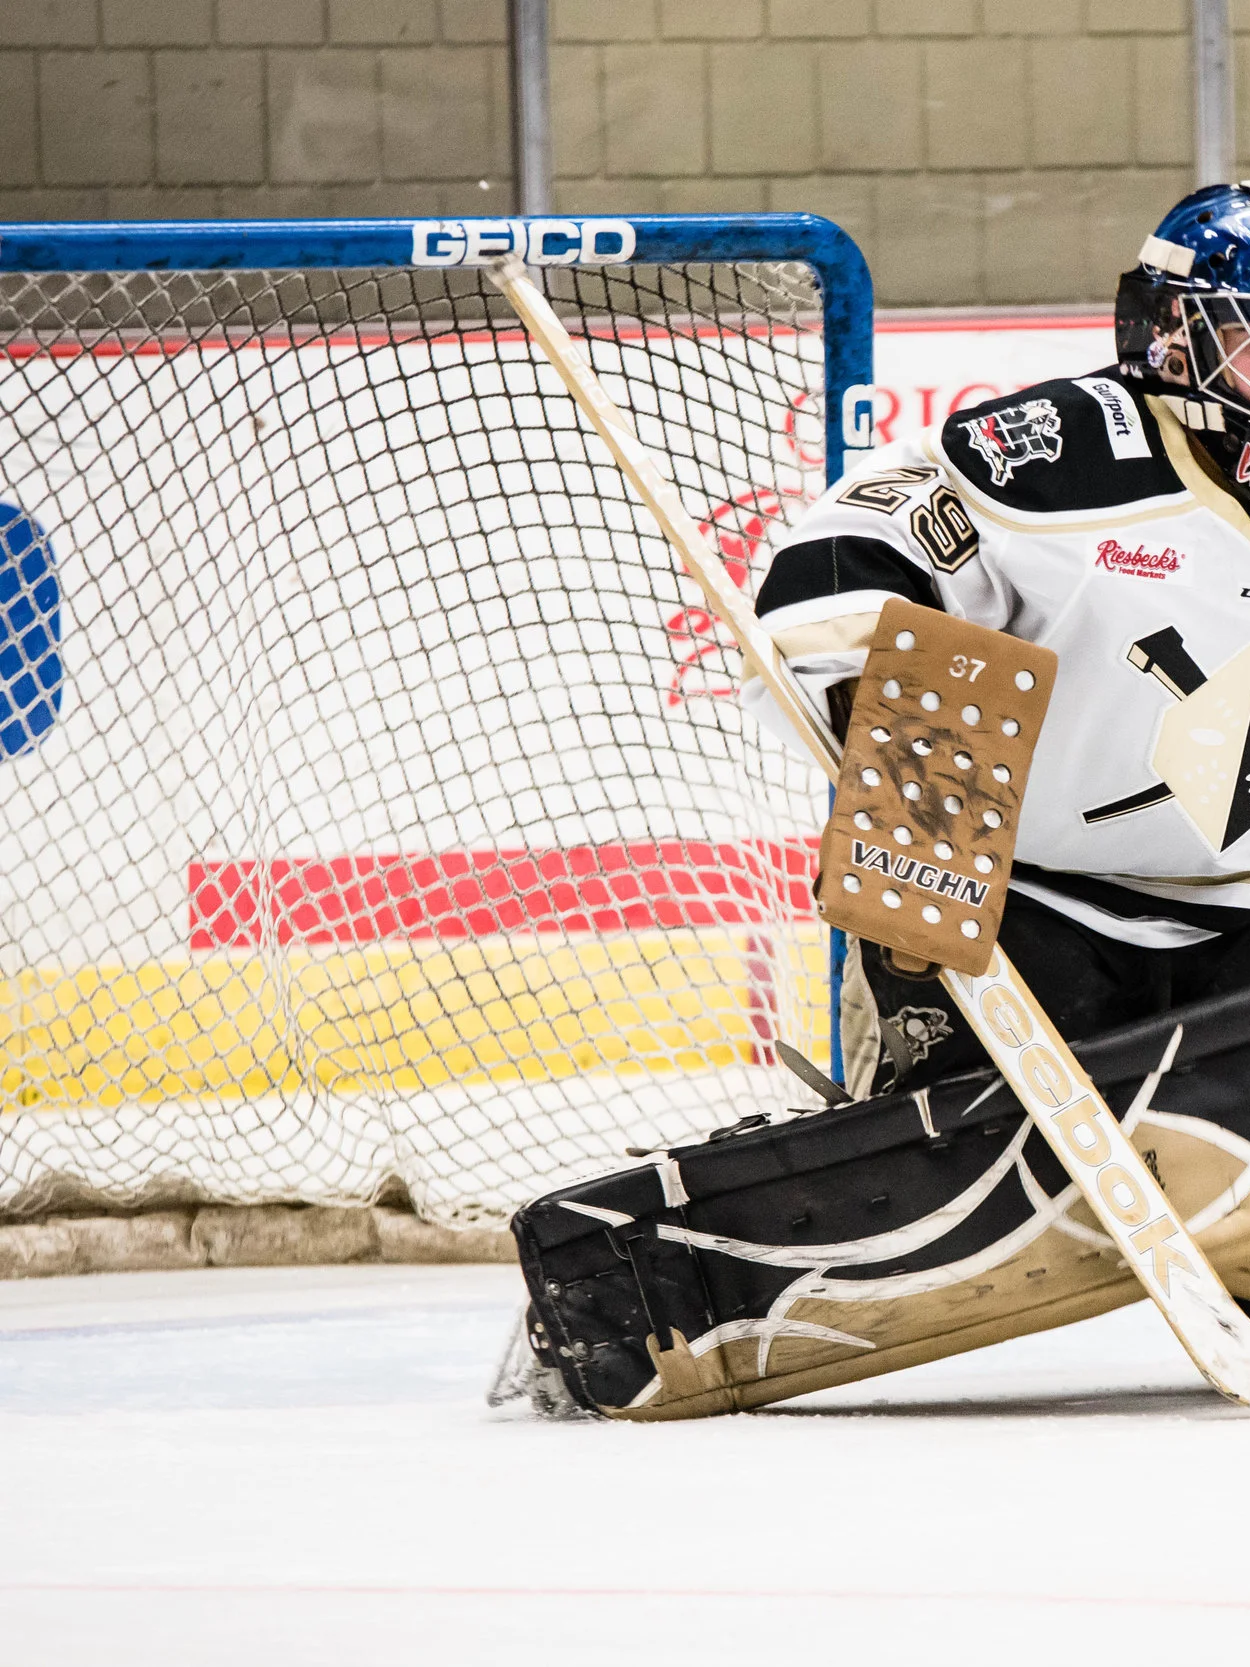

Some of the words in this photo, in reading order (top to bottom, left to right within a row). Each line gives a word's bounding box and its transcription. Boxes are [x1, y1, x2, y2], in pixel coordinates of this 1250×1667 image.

[412, 220, 636, 266] GEICO
[1092, 383, 1131, 437] Gulfport
[836, 466, 980, 575] 29
[1095, 539, 1180, 571] Riesbeck's
[1118, 566, 1136, 576] Food
[1136, 568, 1166, 580] Markets
[949, 654, 987, 683] 37
[850, 839, 991, 909] VAUGHN
[956, 955, 1200, 1297] eebok
